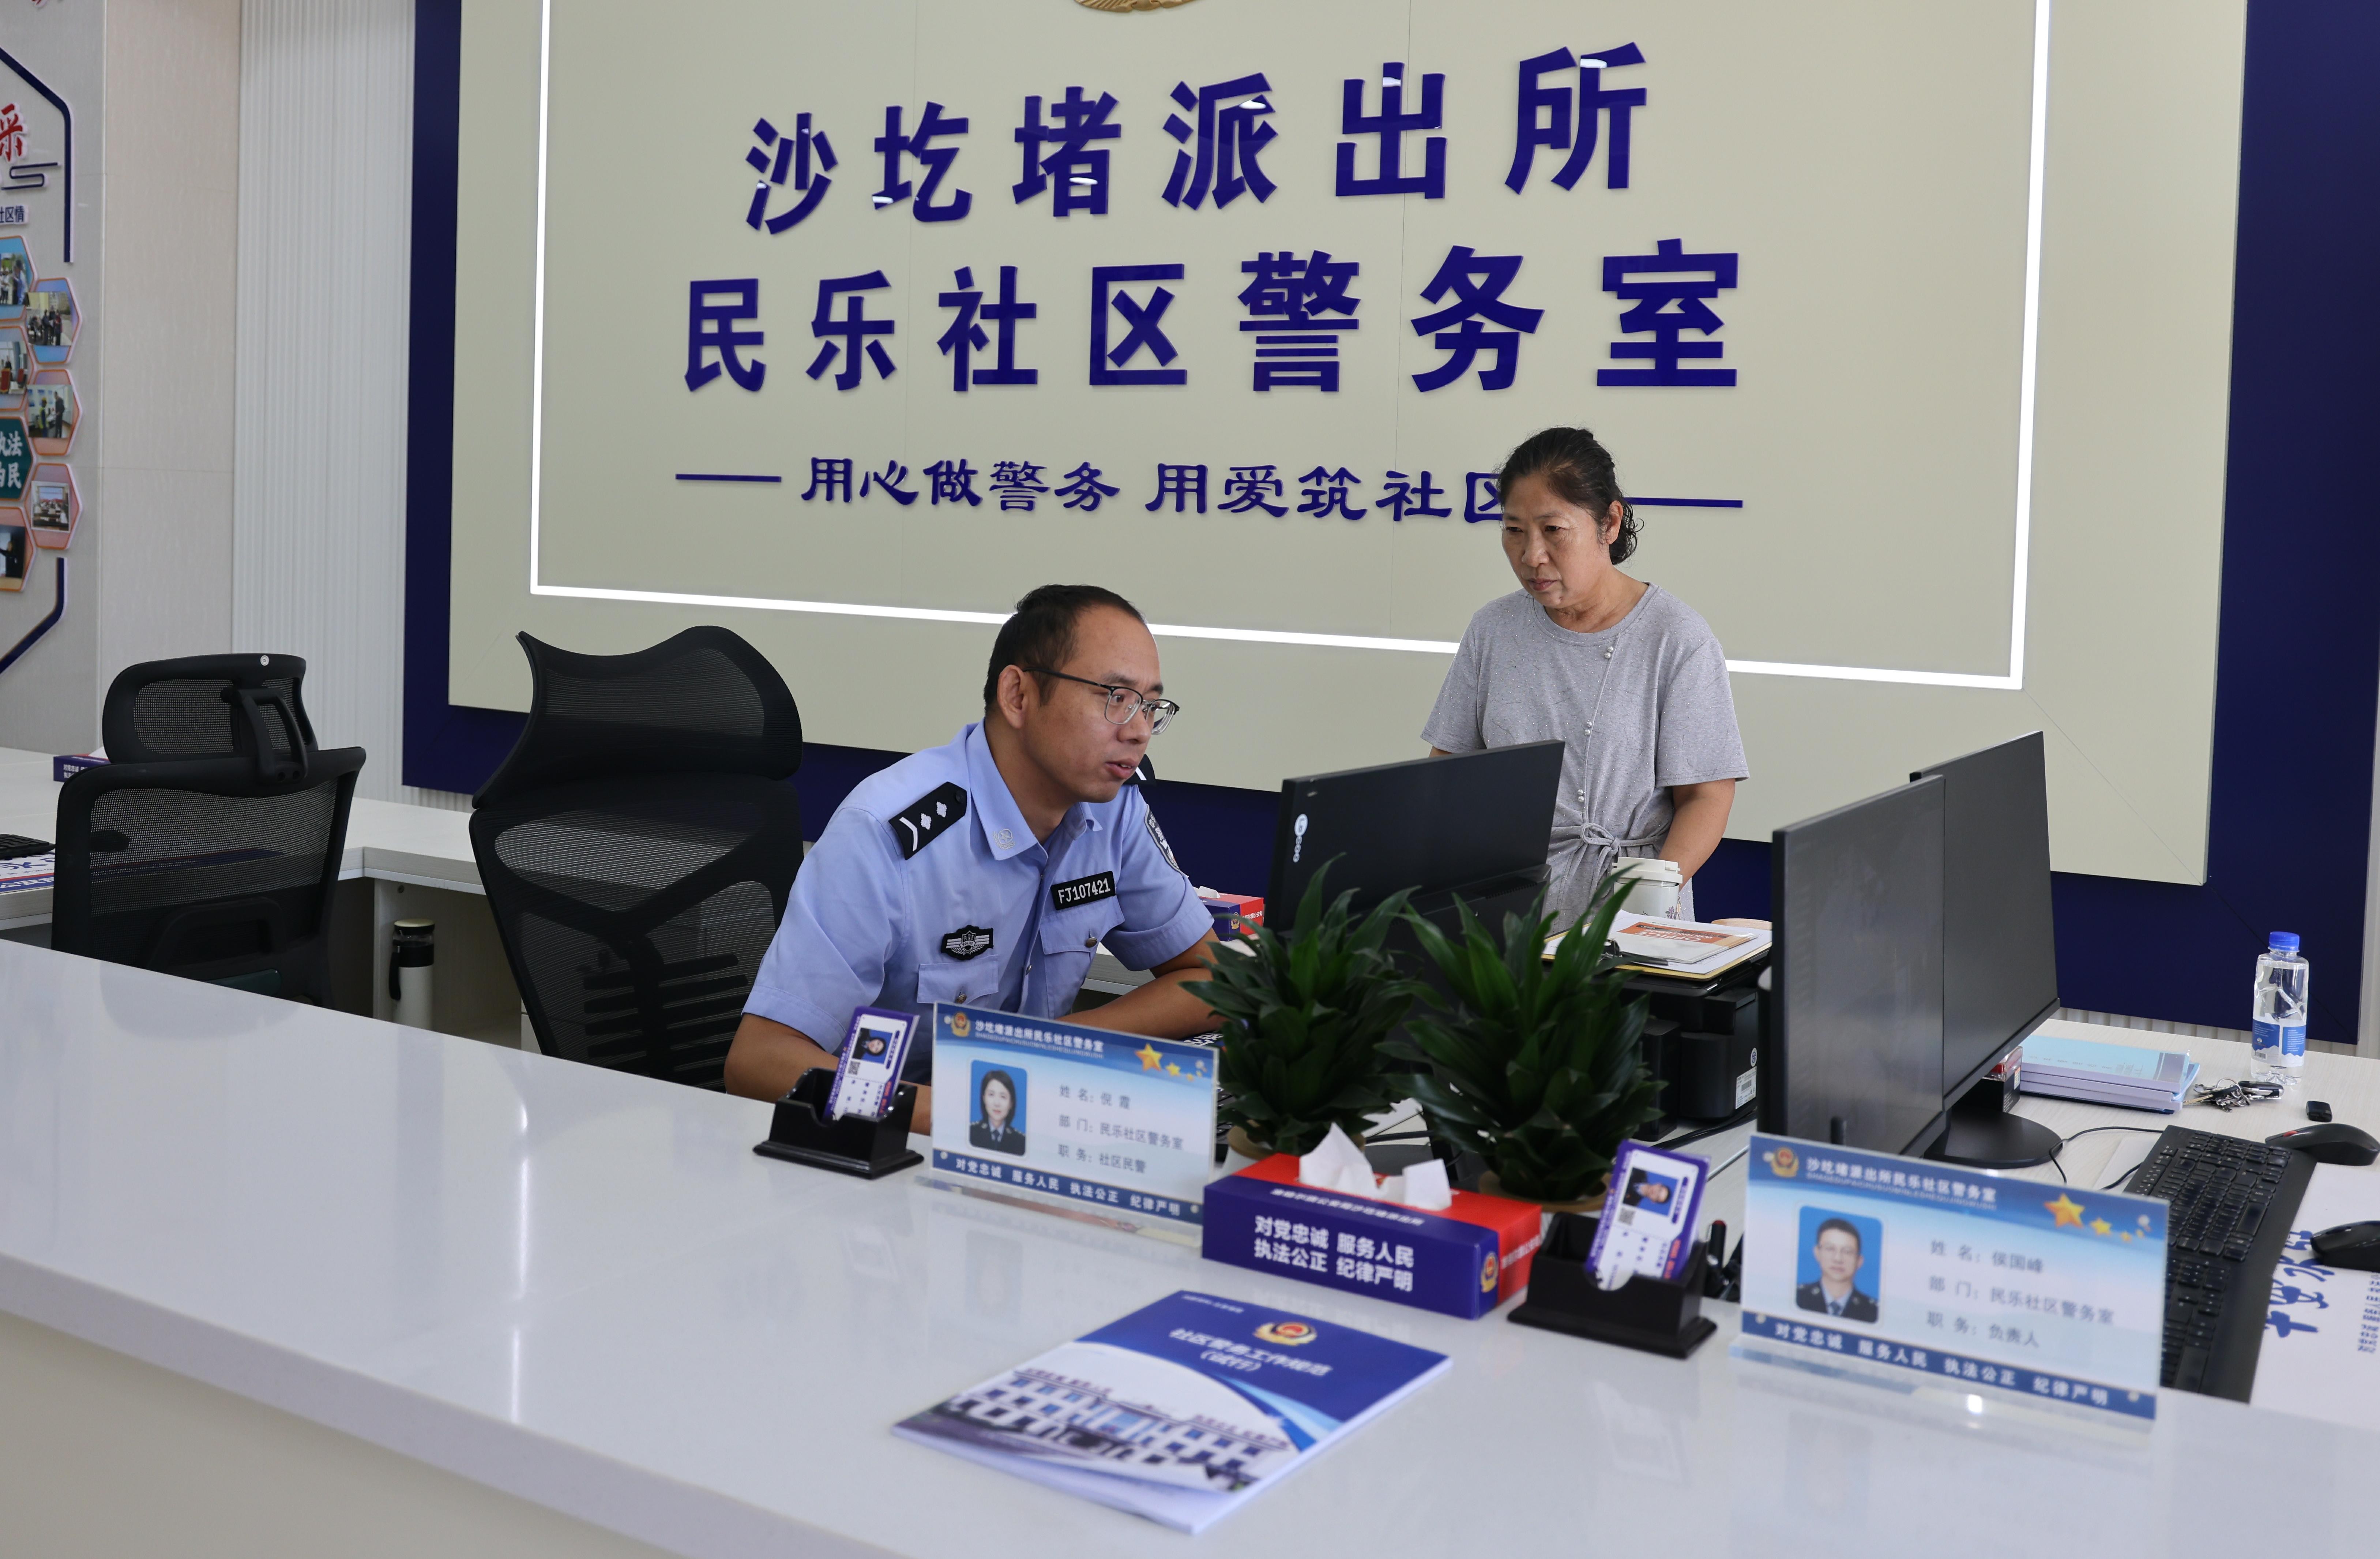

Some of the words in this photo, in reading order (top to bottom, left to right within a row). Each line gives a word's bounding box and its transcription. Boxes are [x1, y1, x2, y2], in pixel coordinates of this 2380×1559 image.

[745, 42, 1646, 234] 沙圪堵派出所
[684, 238, 1739, 393] 民乐社区警务室
[800, 456, 1122, 513] 用心做警务
[1058, 878, 1111, 904] FJ107421
[1635, 932, 1701, 941] OFFICE
[1100, 1122, 1183, 1150] 民乐社区警务室
[956, 1158, 1002, 1178] 对党忠诚
[1012, 1169, 1059, 1191] 服务人民
[1070, 1182, 1119, 1203] 执法公正
[1130, 1194, 1180, 1216] 纪律严明
[1099, 1153, 1146, 1173] 社区民警
[1254, 1237, 1328, 1272] 执法公正
[1336, 1256, 1413, 1292] 纪律严明
[1255, 1215, 1328, 1249] 对党忠诚
[1337, 1232, 1414, 1268] 服务人民
[1990, 1287, 2114, 1324] 民乐社区警务室
[1989, 1323, 2039, 1348] 负责人
[1775, 1322, 1842, 1350] 对党忠诚
[1857, 1338, 1927, 1368] 服务人民
[1944, 1357, 2016, 1386] 执法公正
[2033, 1376, 2108, 1406] 纪律严明
